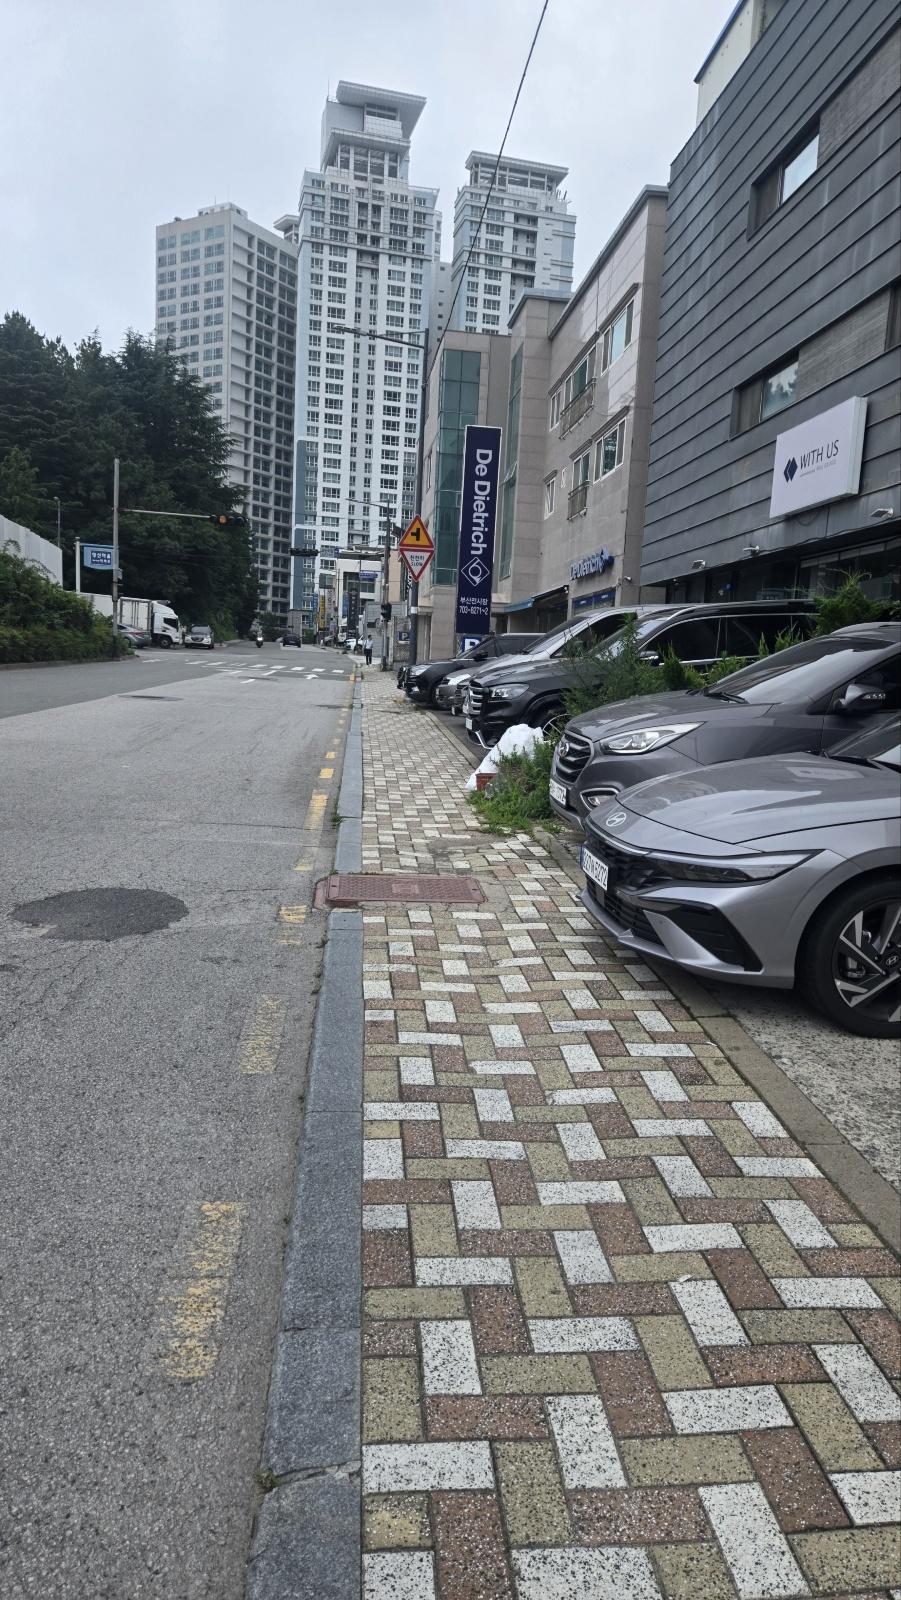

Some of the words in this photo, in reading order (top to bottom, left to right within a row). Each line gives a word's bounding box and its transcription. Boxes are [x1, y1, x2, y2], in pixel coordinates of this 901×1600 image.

[475, 448, 492, 477] De
[800, 446, 824, 470] WITH
[826, 439, 839, 459] US
[471, 480, 491, 555] Dietrich
[401, 632, 408, 640] P
[464, 638, 480, 651] P
